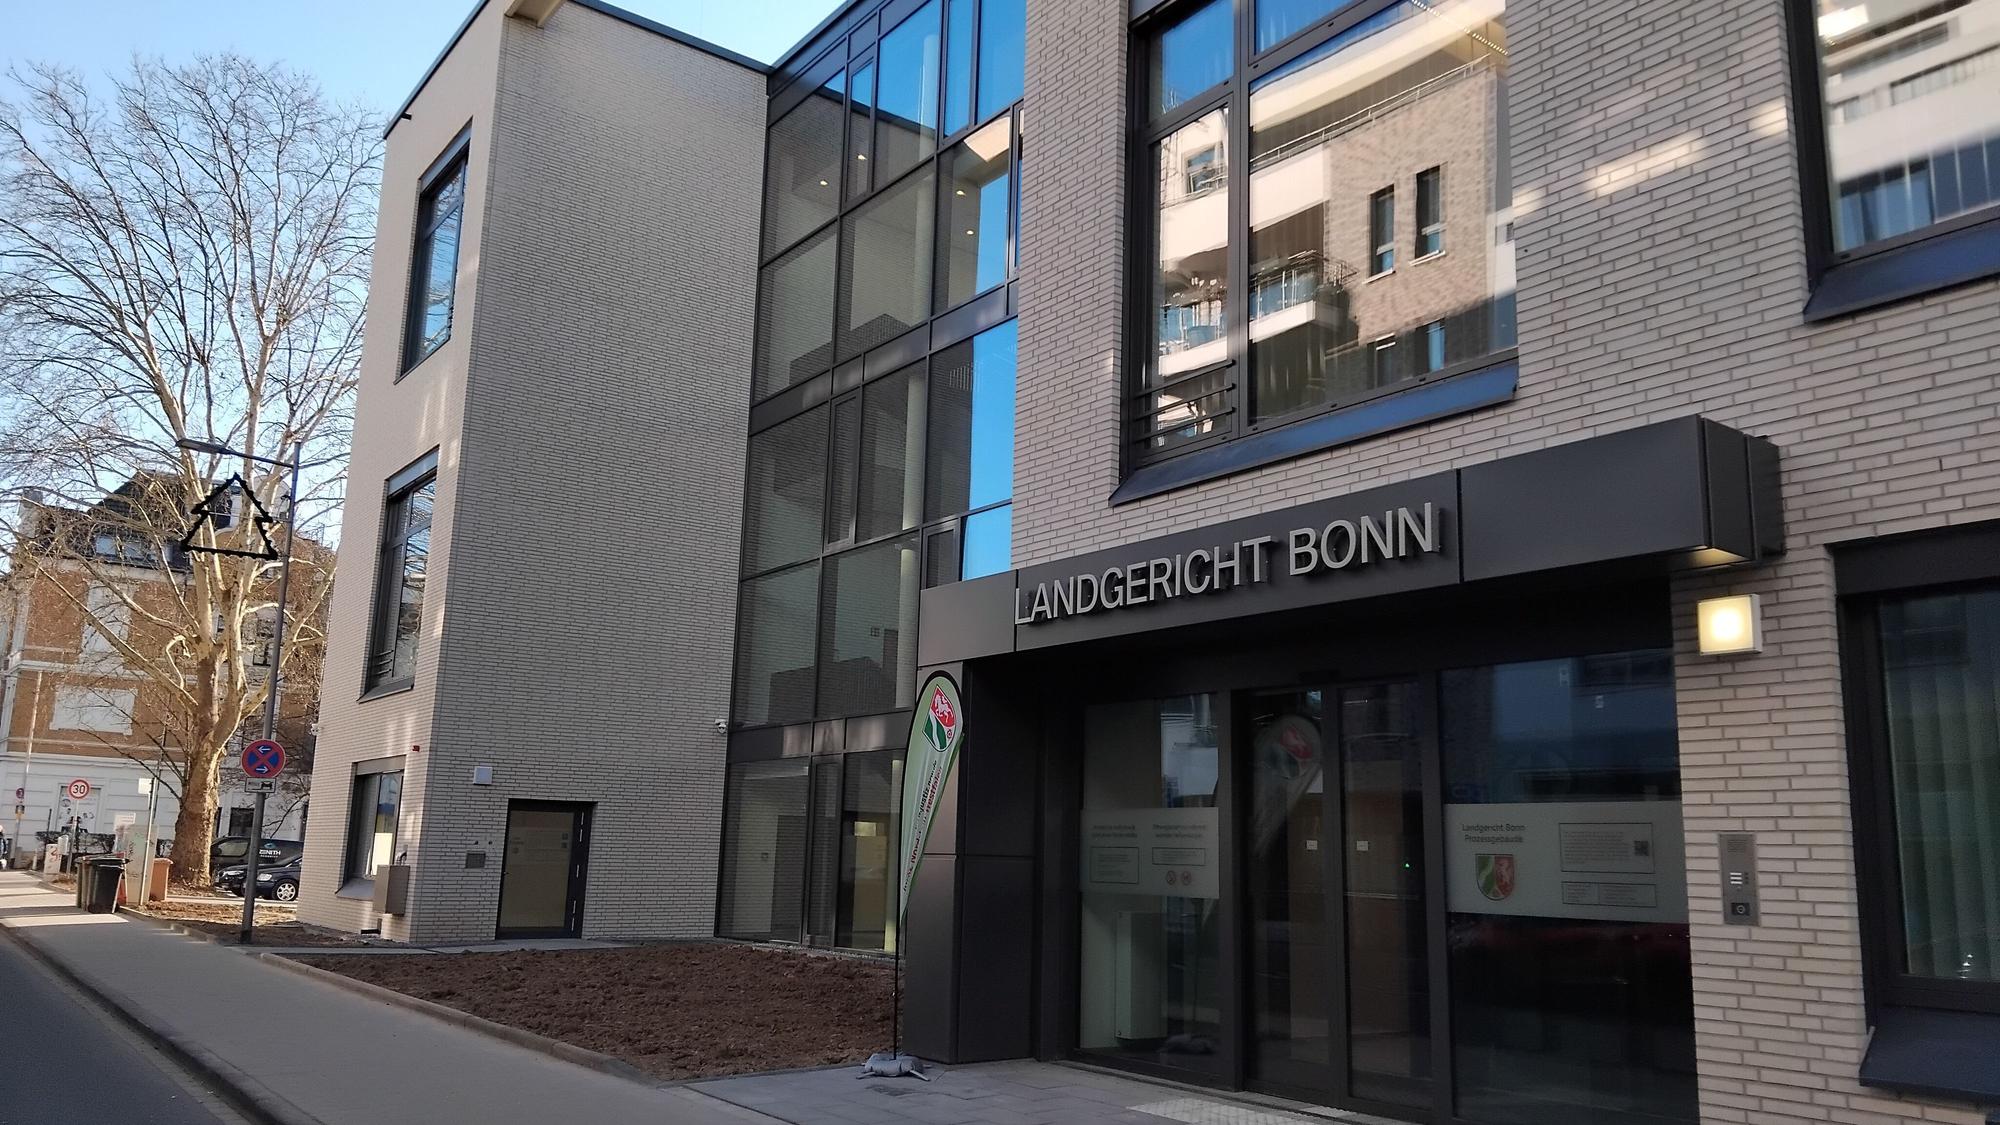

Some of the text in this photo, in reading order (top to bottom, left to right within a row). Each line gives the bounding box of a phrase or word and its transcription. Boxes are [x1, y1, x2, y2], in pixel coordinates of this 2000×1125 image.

[1015, 502, 1438, 625] LANDGERICHT BONN
[73, 784, 86, 794] 30
[1461, 823, 1503, 833] Landgericht
